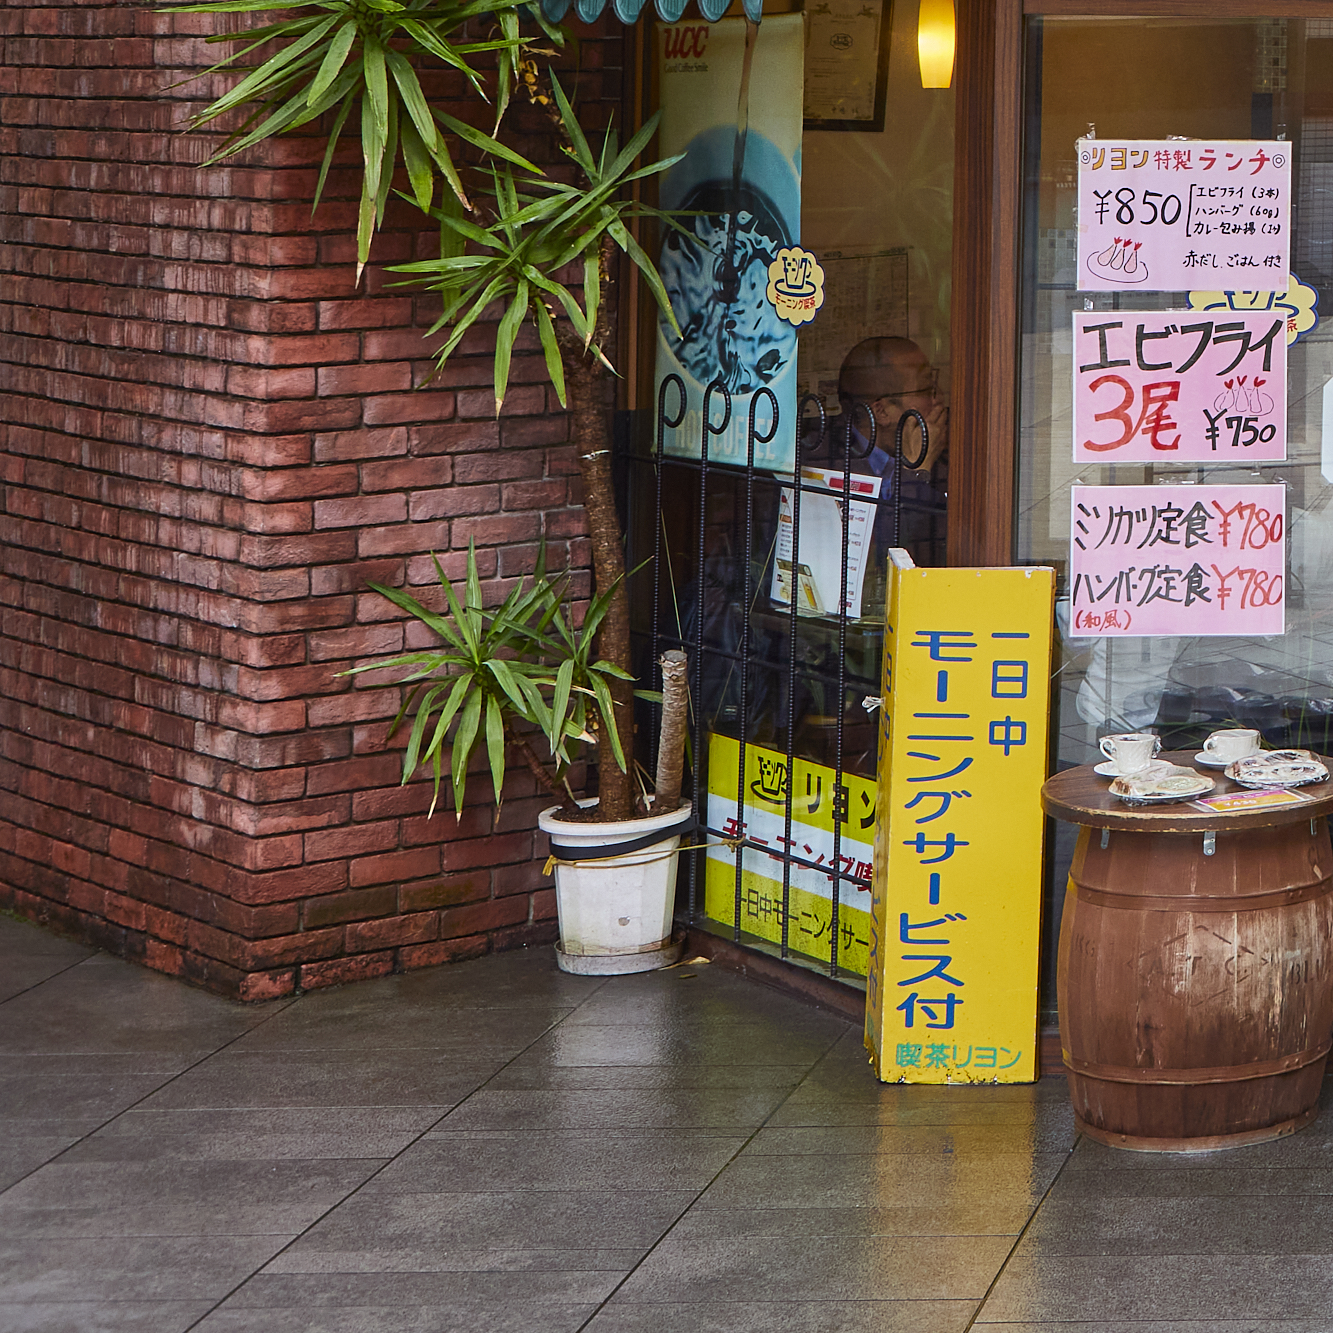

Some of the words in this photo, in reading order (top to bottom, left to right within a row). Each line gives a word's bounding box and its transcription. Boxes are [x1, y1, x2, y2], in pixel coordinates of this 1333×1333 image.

[1093, 187, 1182, 225] ¥850
[1195, 204, 1244, 216] ハンバーグ
[1196, 186, 1245, 198] エビフライ
[1080, 319, 1284, 376] エビフライ
[1083, 375, 1182, 451] 3尾
[1202, 409, 1277, 451] ¥750
[1212, 500, 1283, 550] ¥780
[1210, 563, 1283, 610] ¥780
[989, 632, 1030, 756] 一日中
[897, 630, 978, 1029] モーニングサービス付
[896, 1043, 1022, 1070] 喫茶リヨン
